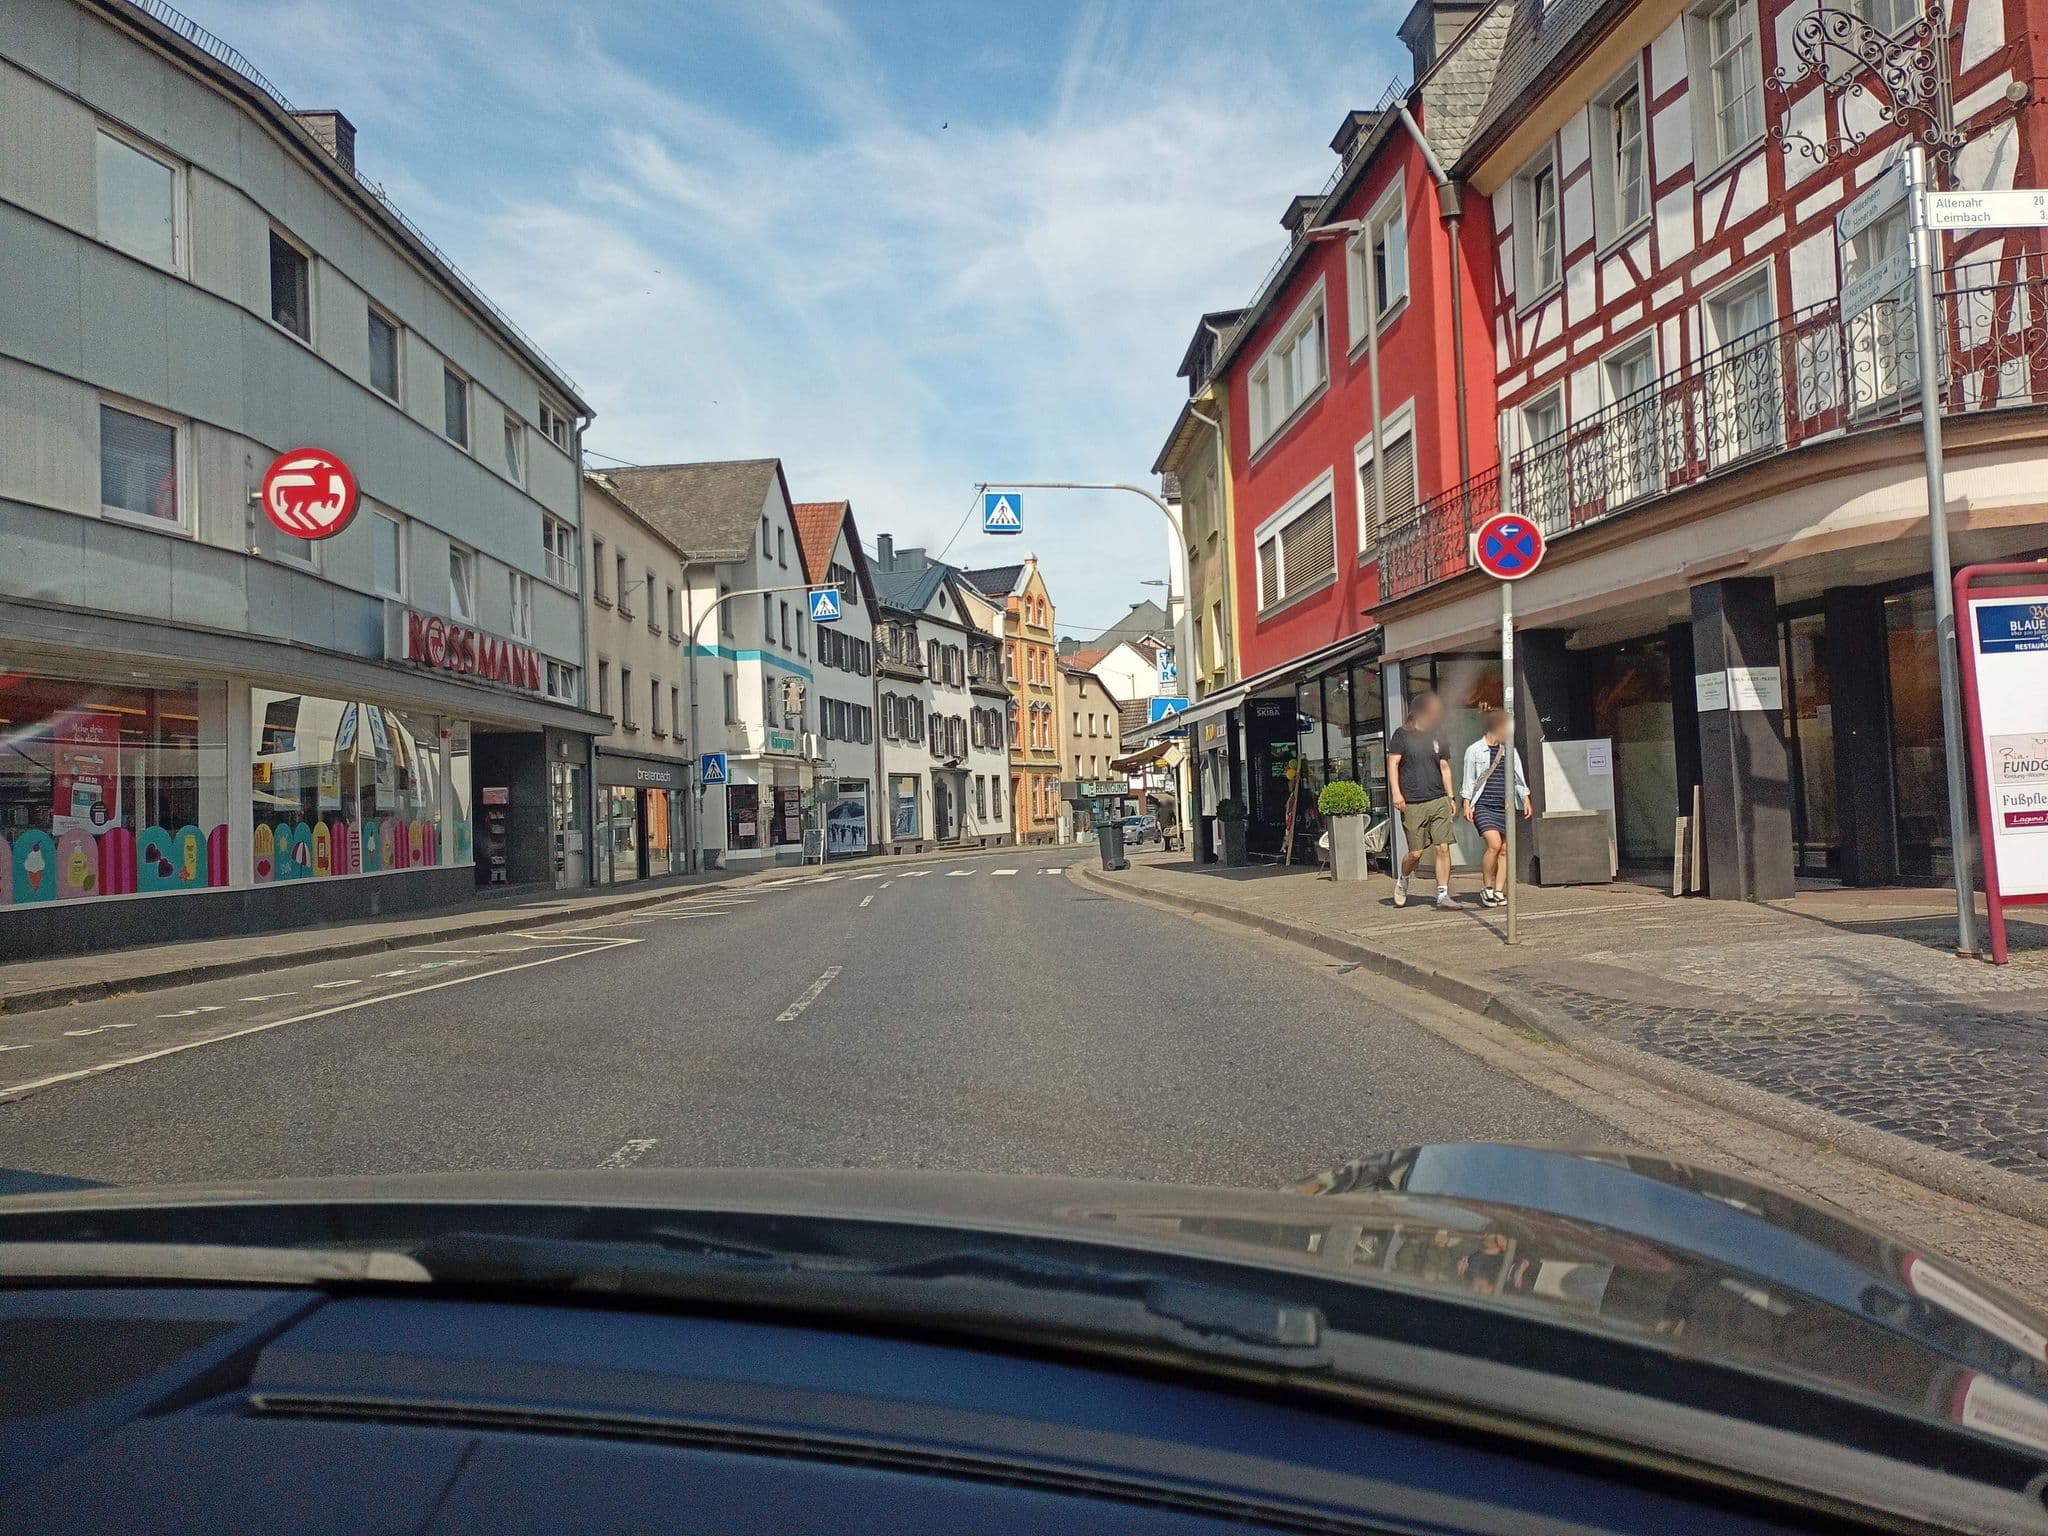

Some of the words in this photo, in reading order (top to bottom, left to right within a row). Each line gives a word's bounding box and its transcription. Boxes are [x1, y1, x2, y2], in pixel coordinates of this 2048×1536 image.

[1936, 198, 1983, 208] Altenahr
[2034, 196, 2044, 205] 20
[1936, 212, 1991, 223] Leimbach
[2010, 619, 2047, 632] BLAUE
[408, 609, 541, 691] ROSSMANN
[1256, 709, 1280, 717] SKIBA
[1095, 783, 1128, 793] REINIGUNG
[350, 831, 361, 868] HELLO
